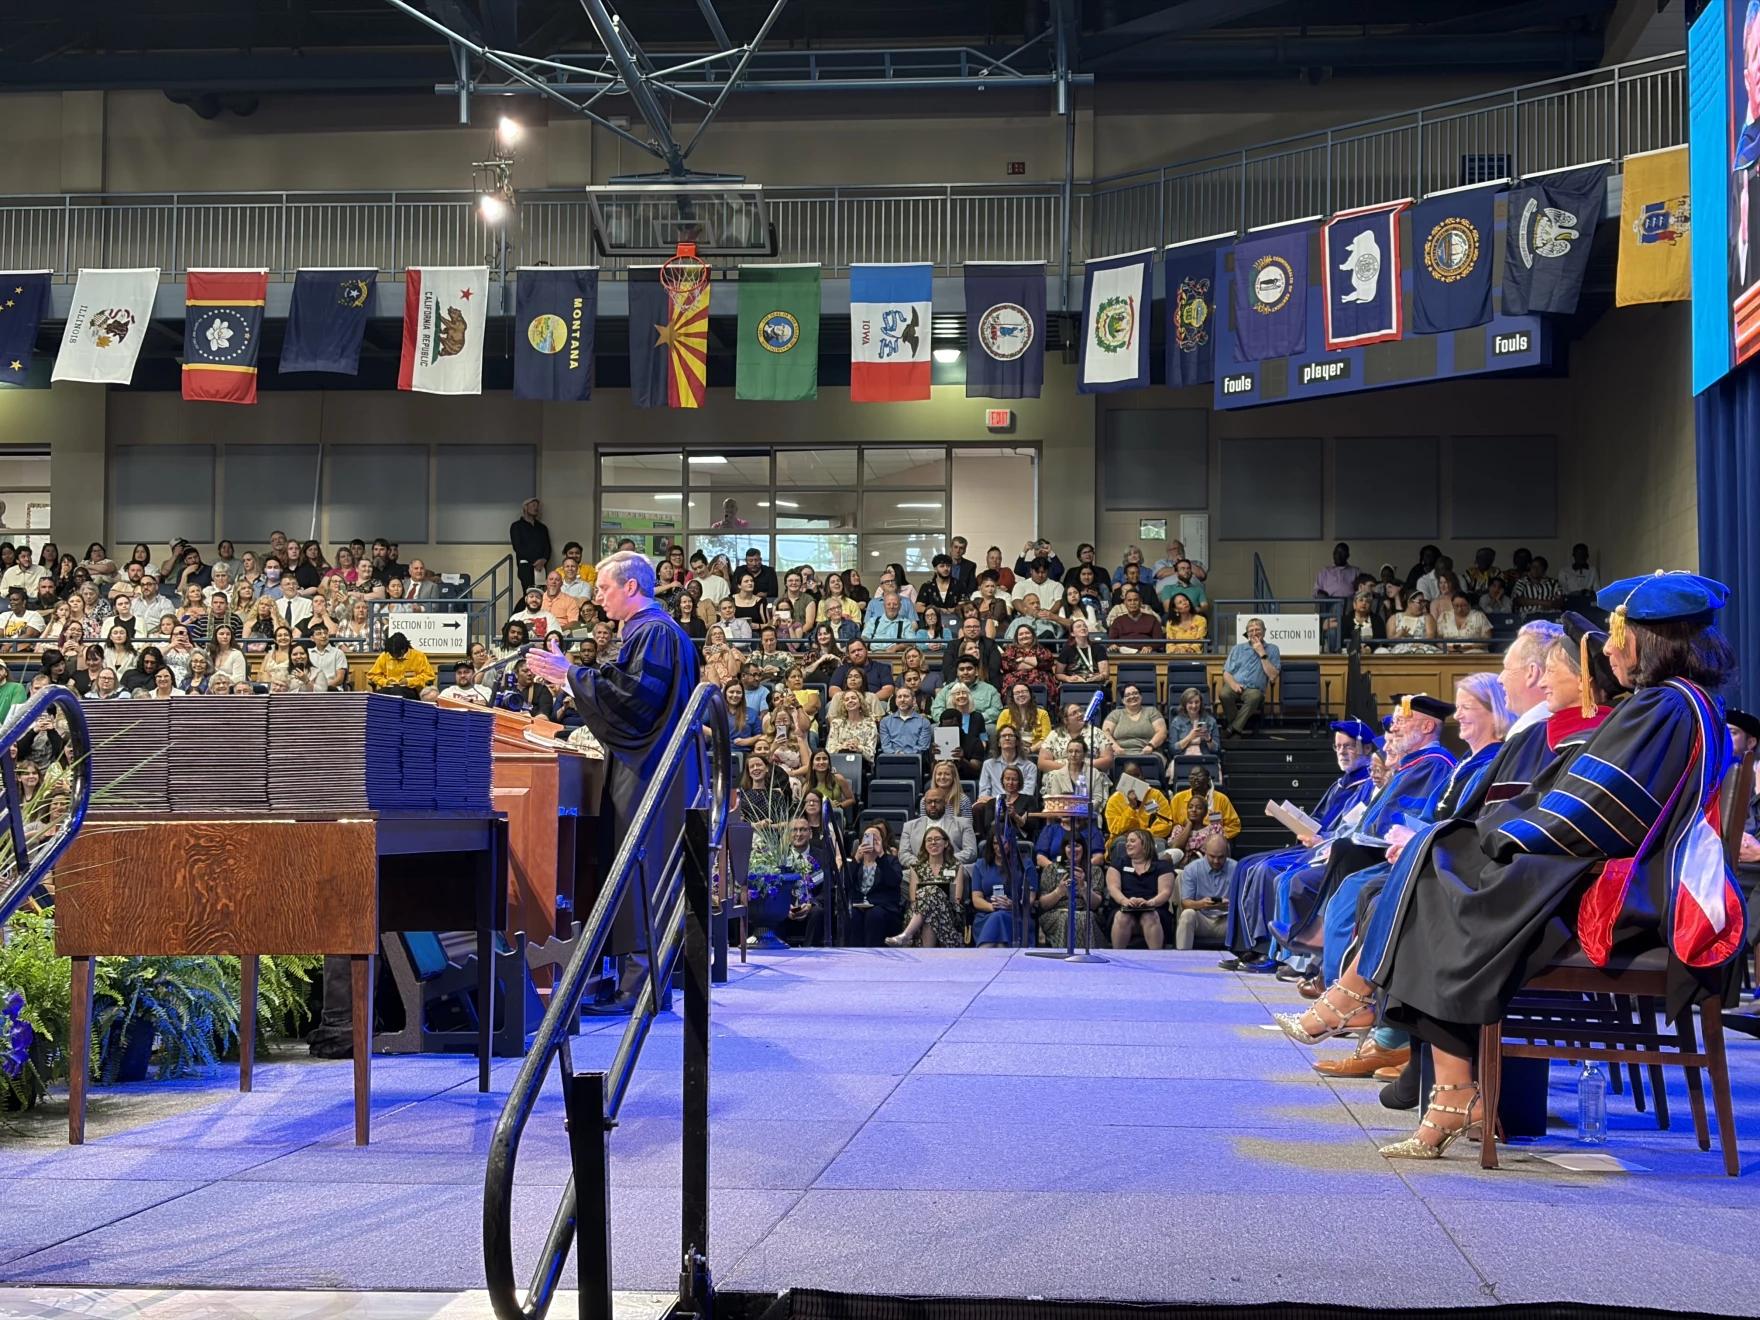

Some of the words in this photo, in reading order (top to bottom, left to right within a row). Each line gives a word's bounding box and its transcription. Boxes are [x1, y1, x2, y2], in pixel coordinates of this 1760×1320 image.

[423, 291, 433, 330] CALIFORNIA
[69, 304, 88, 344] ILLINOIS
[569, 298, 583, 369] MONTANA
[862, 320, 870, 345] IOWA
[420, 334, 431, 367] REPUBLIC
[1495, 333, 1527, 354] fouls
[1303, 363, 1344, 384] player
[1224, 375, 1252, 394] fouls
[392, 620, 422, 630] SECTION
[424, 620, 436, 630] 101
[1270, 630, 1301, 640] SECTION
[1304, 630, 1316, 640] 101
[419, 638, 448, 647] SECTION
[451, 638, 463, 647] 102
[1286, 754, 1293, 763] H
[1292, 779, 1299, 788] G
